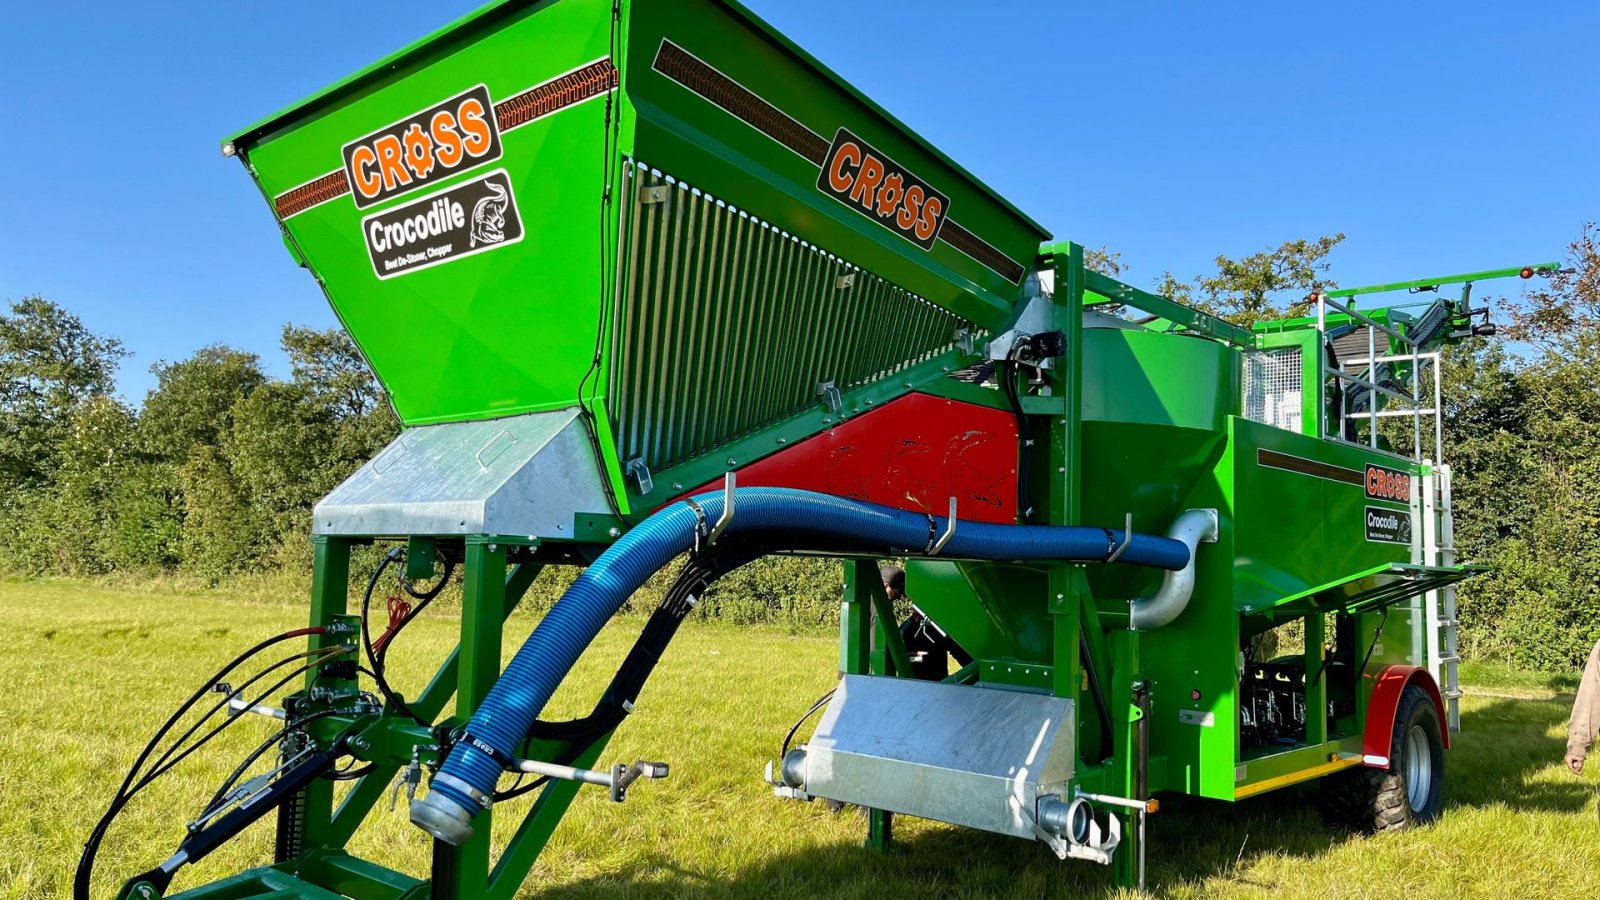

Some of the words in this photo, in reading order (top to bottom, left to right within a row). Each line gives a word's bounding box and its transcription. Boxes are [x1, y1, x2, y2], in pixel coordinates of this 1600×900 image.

[351, 98, 492, 198] CROSS
[828, 142, 942, 240] CROSS
[370, 197, 465, 253] Crocodile
[426, 244, 453, 258] Chopper
[1367, 467, 1410, 501] CROSS
[1367, 512, 1398, 530] Crocodile
